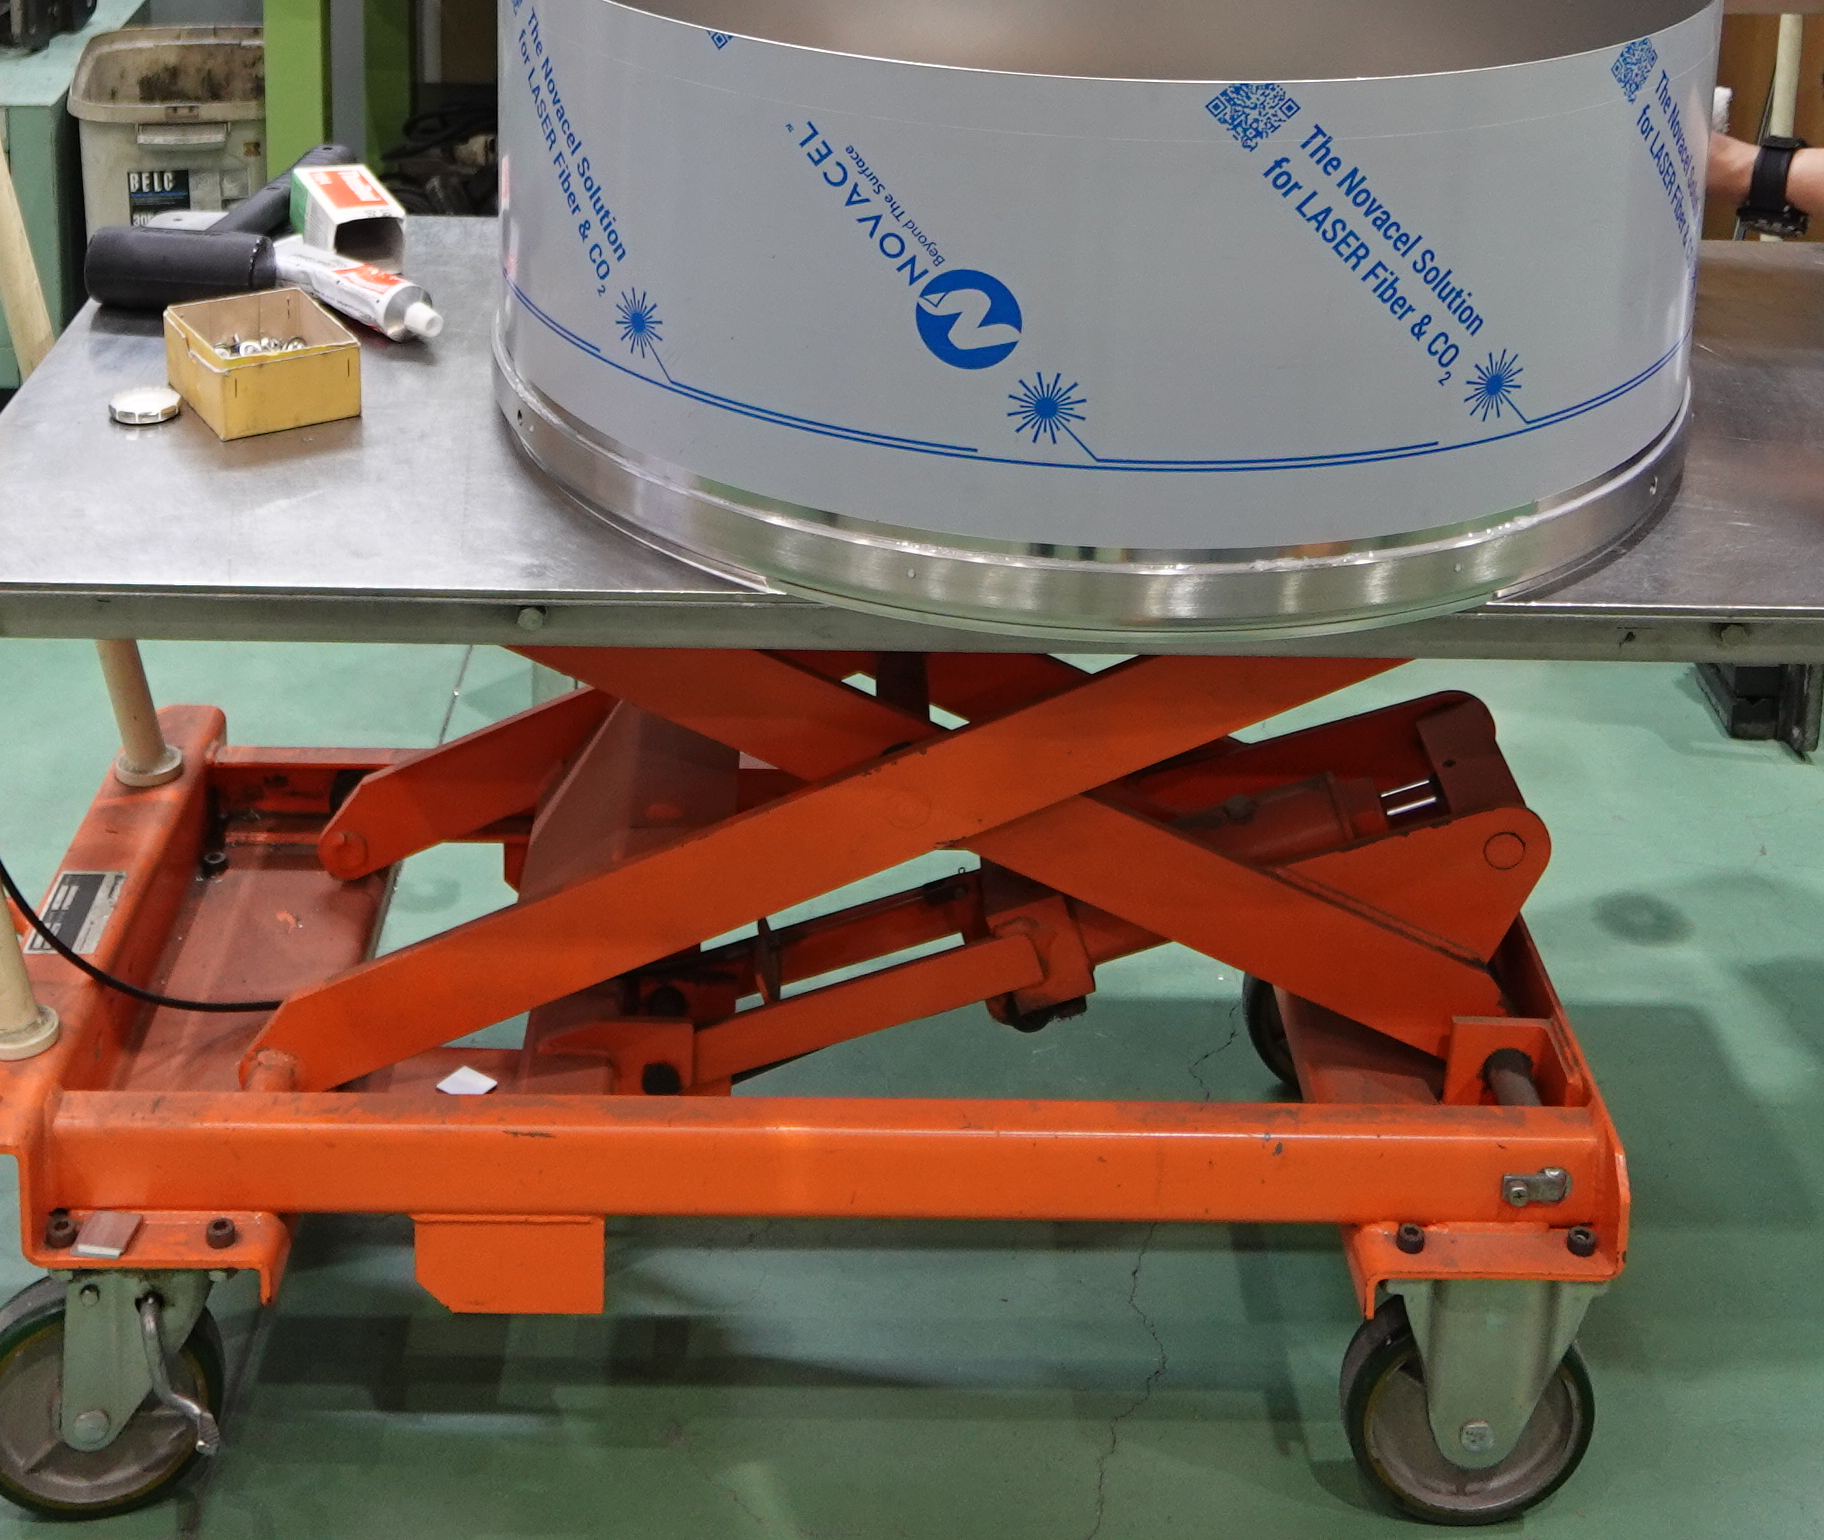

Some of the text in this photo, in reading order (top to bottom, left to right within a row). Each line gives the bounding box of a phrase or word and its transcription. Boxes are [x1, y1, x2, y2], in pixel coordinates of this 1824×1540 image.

[518, 29, 531, 64] for
[527, 67, 557, 153] LASER
[553, 151, 581, 217] Fiber
[578, 219, 592, 241] &
[527, 7, 627, 262] The Novacel Solution
[798, 121, 930, 287] NOVACEL
[845, 145, 945, 268] Beyond The Surface
[1637, 103, 1654, 142] for
[1649, 130, 1677, 196] LASER
[1655, 69, 1672, 115] The
[1667, 102, 1692, 177] Novacel
[1263, 155, 1304, 199] for
[1295, 191, 1372, 271] LASER
[1360, 261, 1417, 321] Fiber
[1409, 314, 1434, 341] &
[1299, 124, 1485, 337] The Novacel Solution
